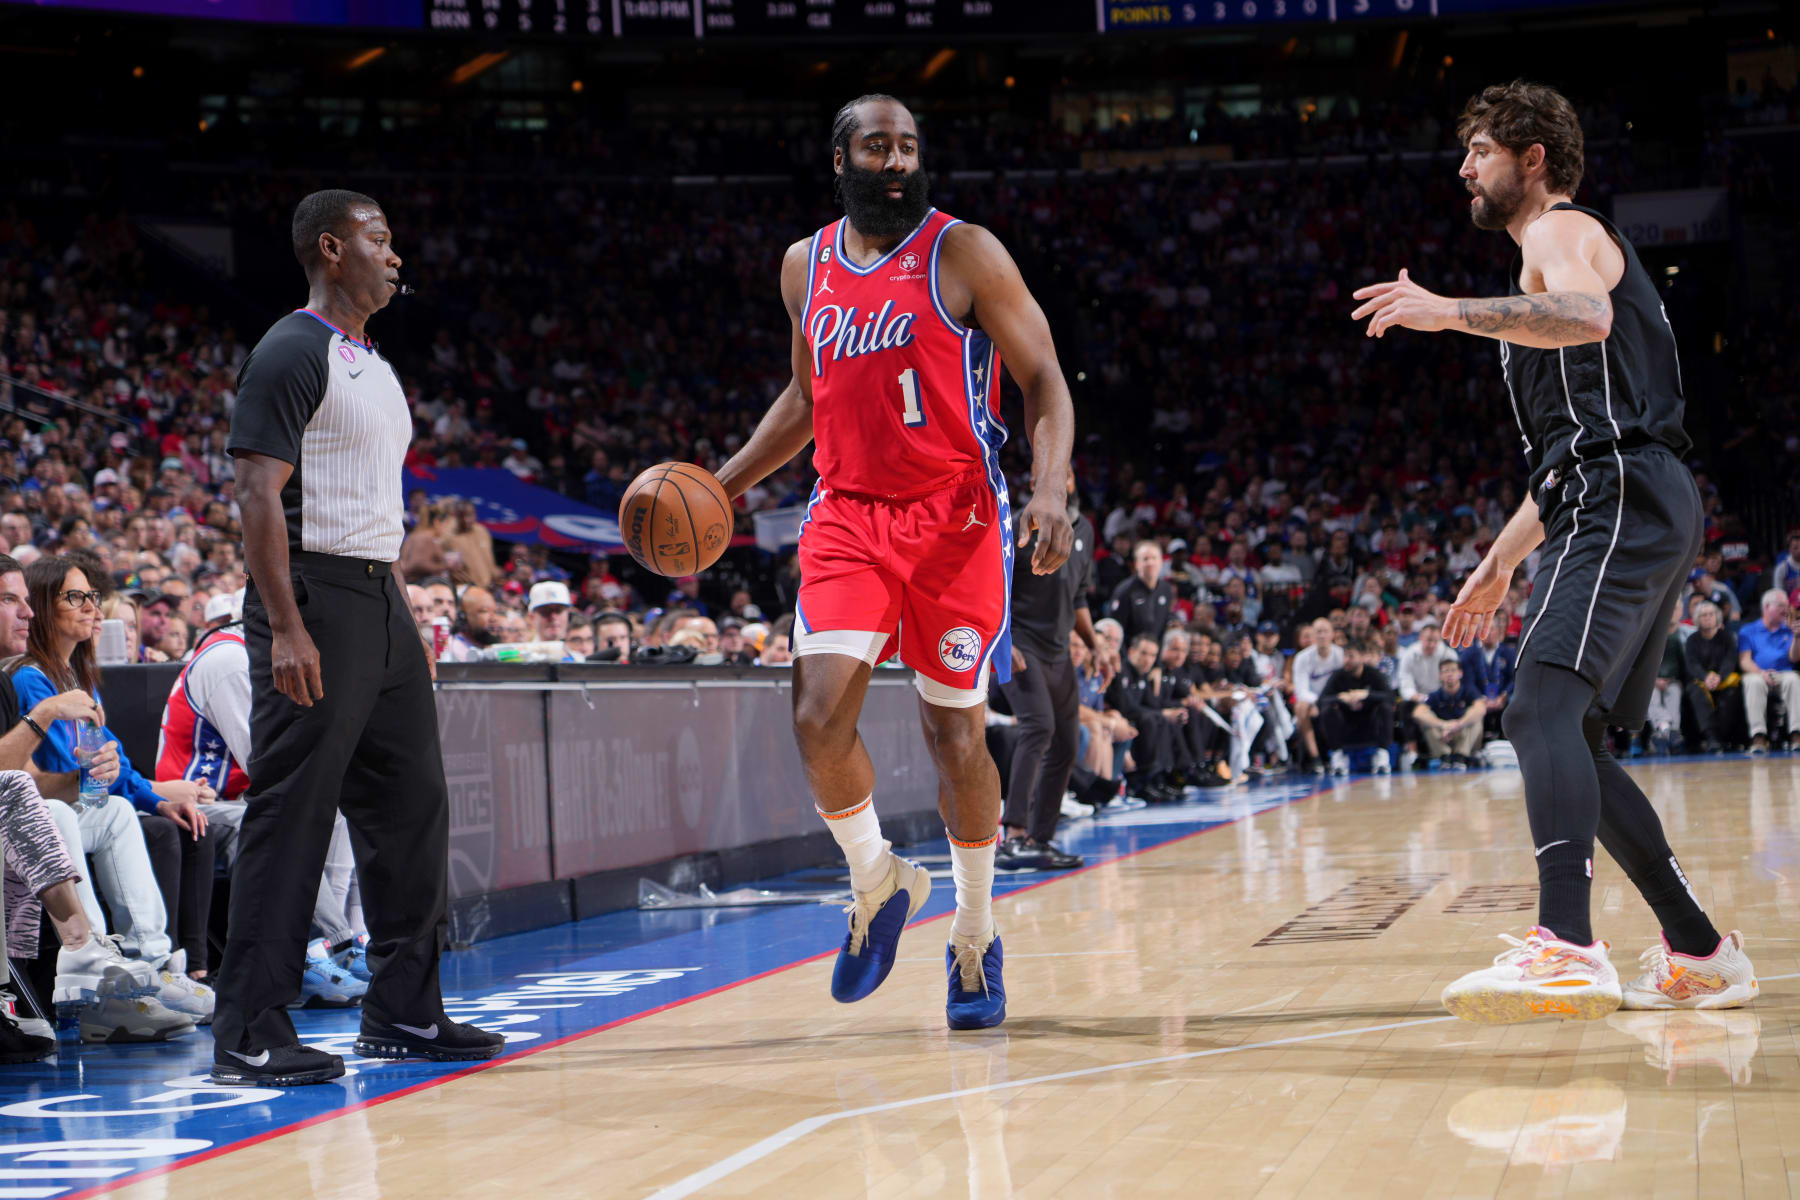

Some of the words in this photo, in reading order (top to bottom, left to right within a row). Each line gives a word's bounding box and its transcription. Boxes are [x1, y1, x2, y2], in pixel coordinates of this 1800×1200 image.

[660, 0, 690, 18] PM
[1111, 6, 1171, 23] POINTS
[1243, 3, 1256, 17] 0
[430, 10, 471, 29] BKN
[553, 14, 567, 32] 2
[586, 15, 602, 34] 0
[820, 247, 831, 263] 6
[889, 272, 927, 282] crypto.com
[811, 300, 917, 378] Phila
[898, 368, 927, 428] 1
[943, 639, 976, 662] 76ers
[506, 742, 592, 850] TONIGHT
[437, 967, 702, 1012] Pixel
